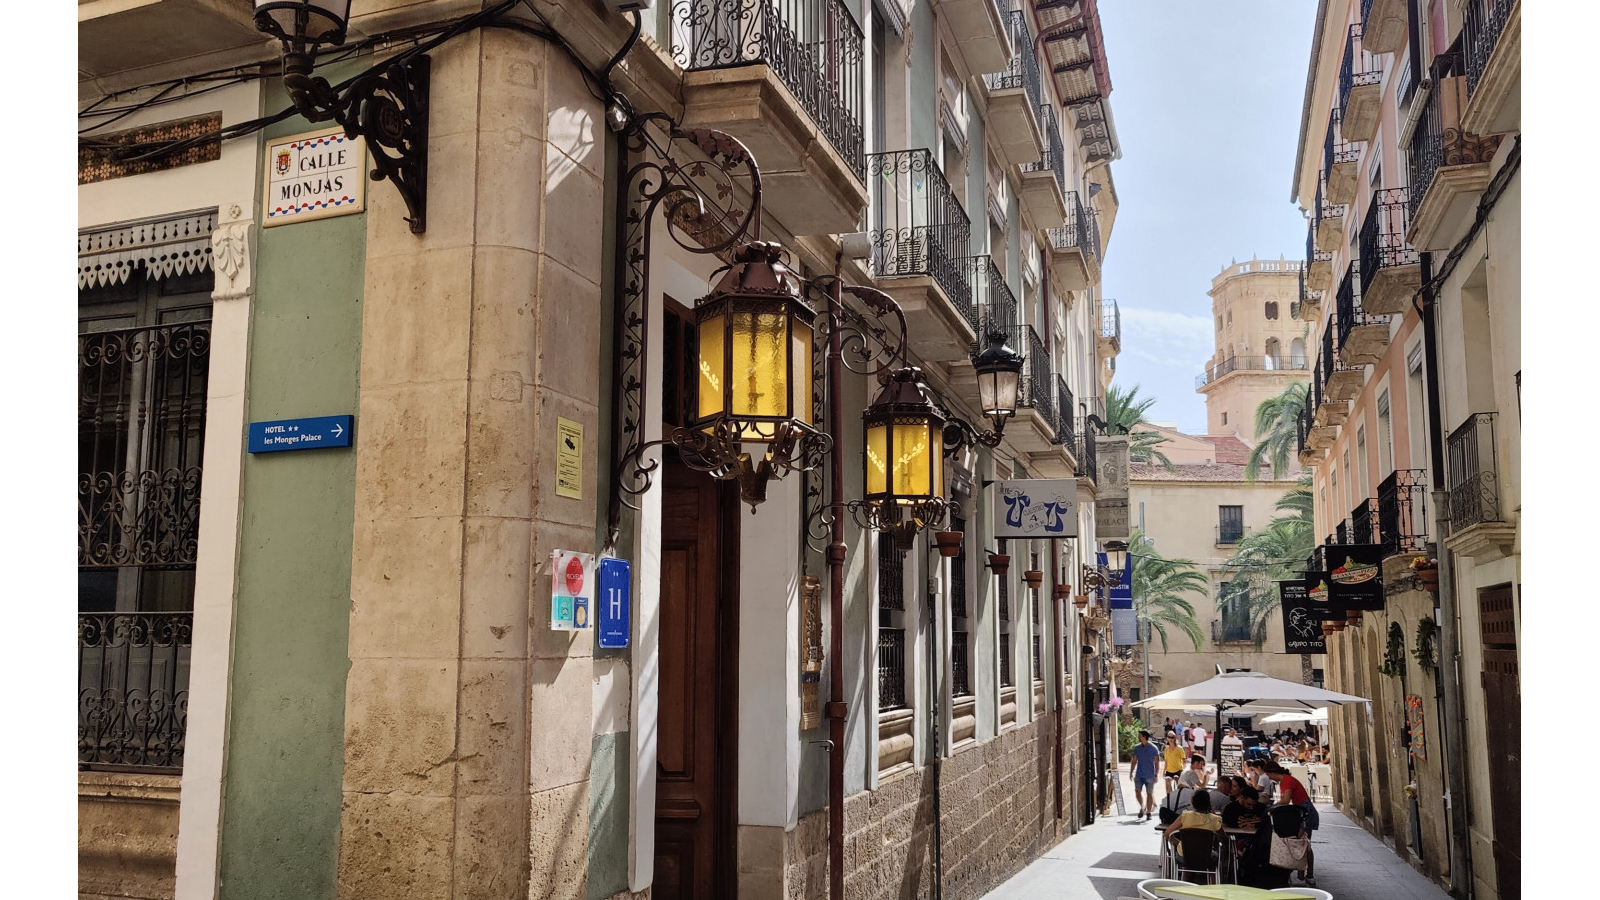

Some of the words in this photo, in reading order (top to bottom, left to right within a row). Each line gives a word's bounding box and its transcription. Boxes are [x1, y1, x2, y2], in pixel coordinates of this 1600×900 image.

[300, 149, 347, 172] CALLE
[281, 175, 343, 200] MONJAS
[265, 426, 286, 434] HOTEL
[274, 435, 299, 445] Monges
[300, 433, 322, 442] Palace
[1028, 520, 1045, 529] BAR
[1097, 517, 1127, 526] PALACE
